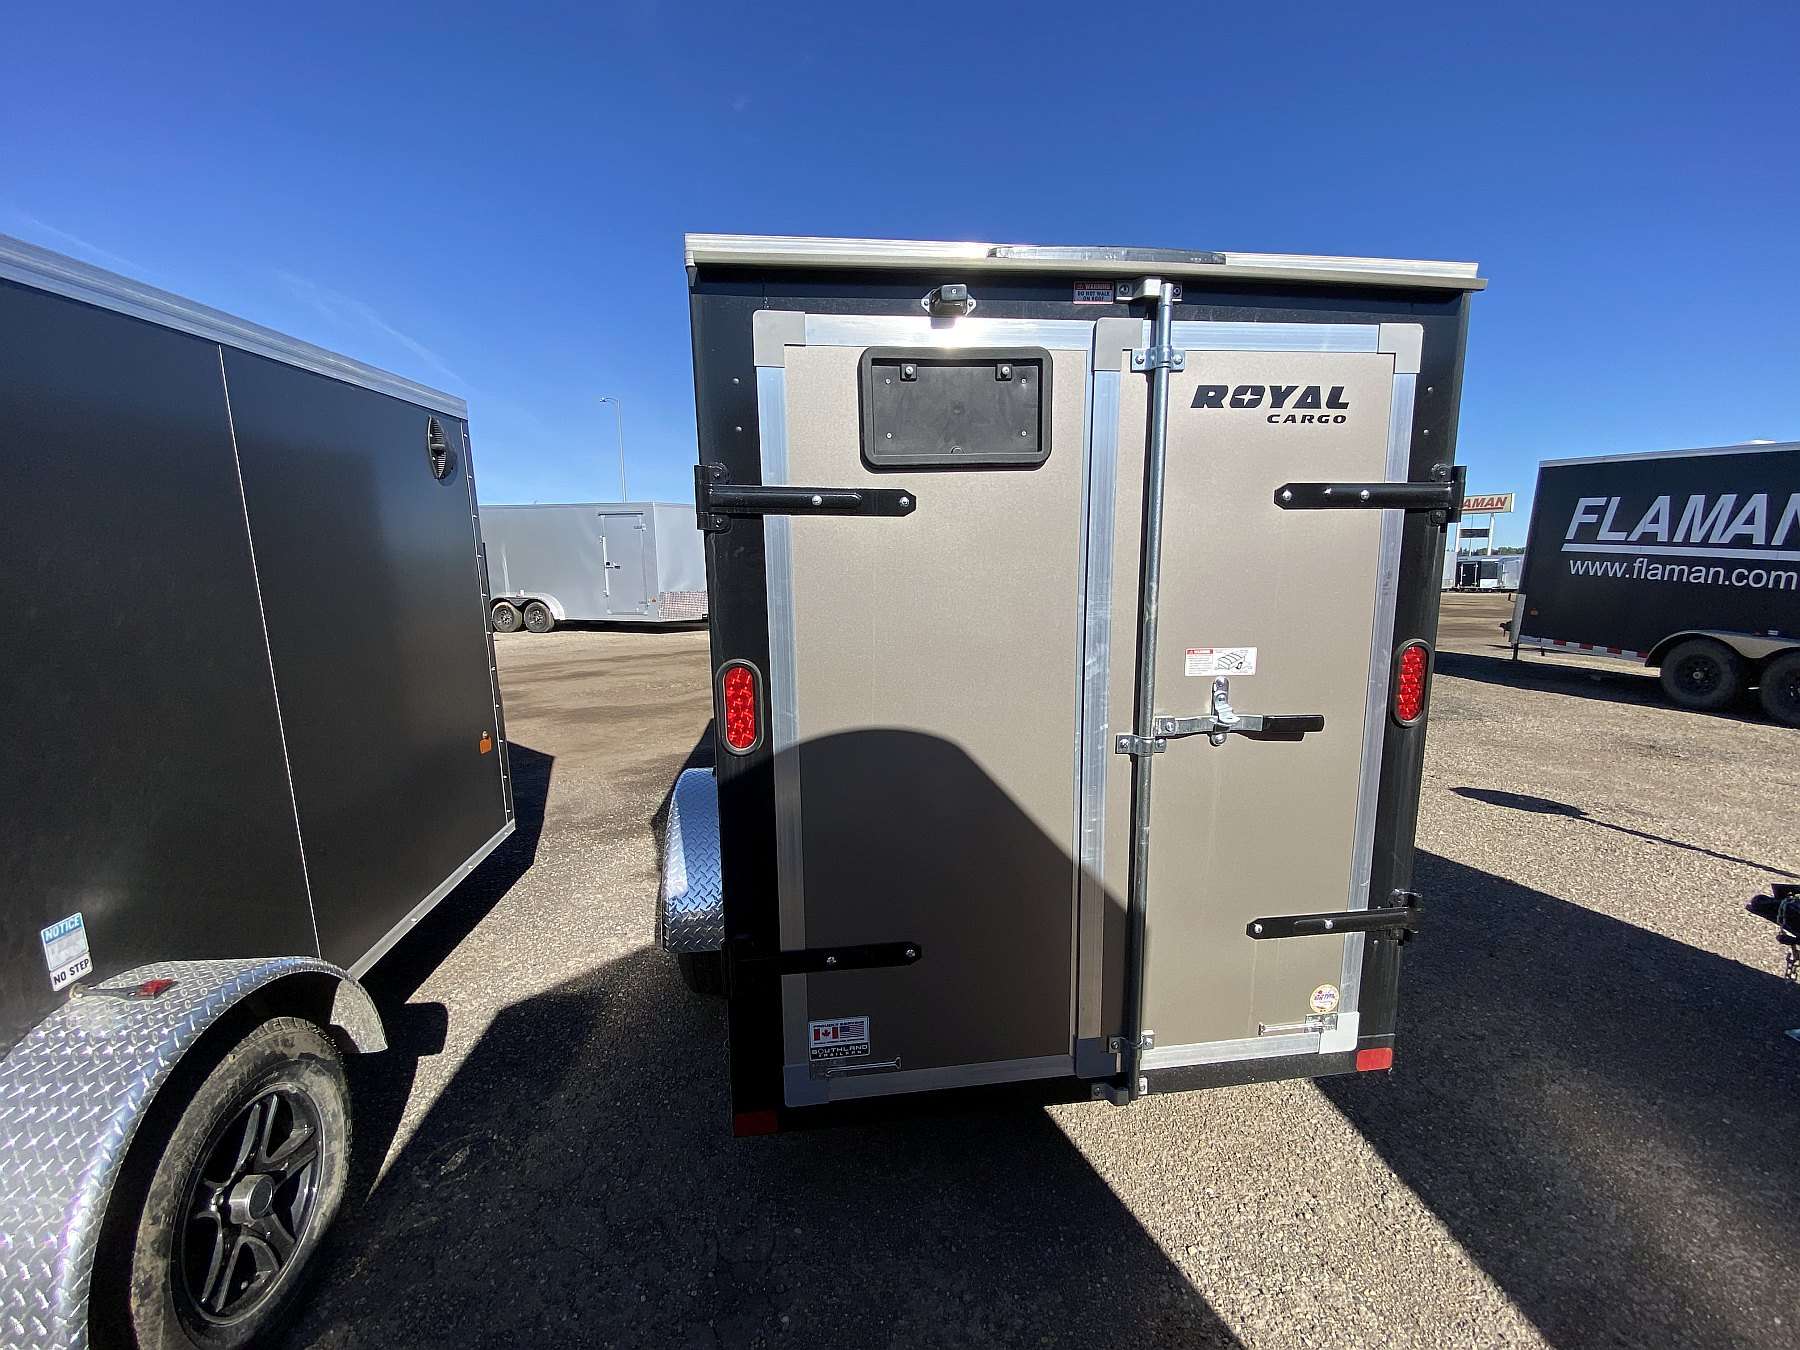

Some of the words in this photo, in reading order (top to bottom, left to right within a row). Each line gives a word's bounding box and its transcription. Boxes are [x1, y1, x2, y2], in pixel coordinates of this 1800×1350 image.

[1190, 385, 1349, 409] ROYAL
[1266, 414, 1347, 424] CARGO
[1463, 496, 1508, 508] AMAN
[1569, 557, 1798, 590] www.flaman.com
[45, 916, 80, 941] NOTICE
[53, 971, 67, 985] NO
[69, 958, 89, 976] STEP
[812, 1044, 868, 1055] SOUTHLAND
